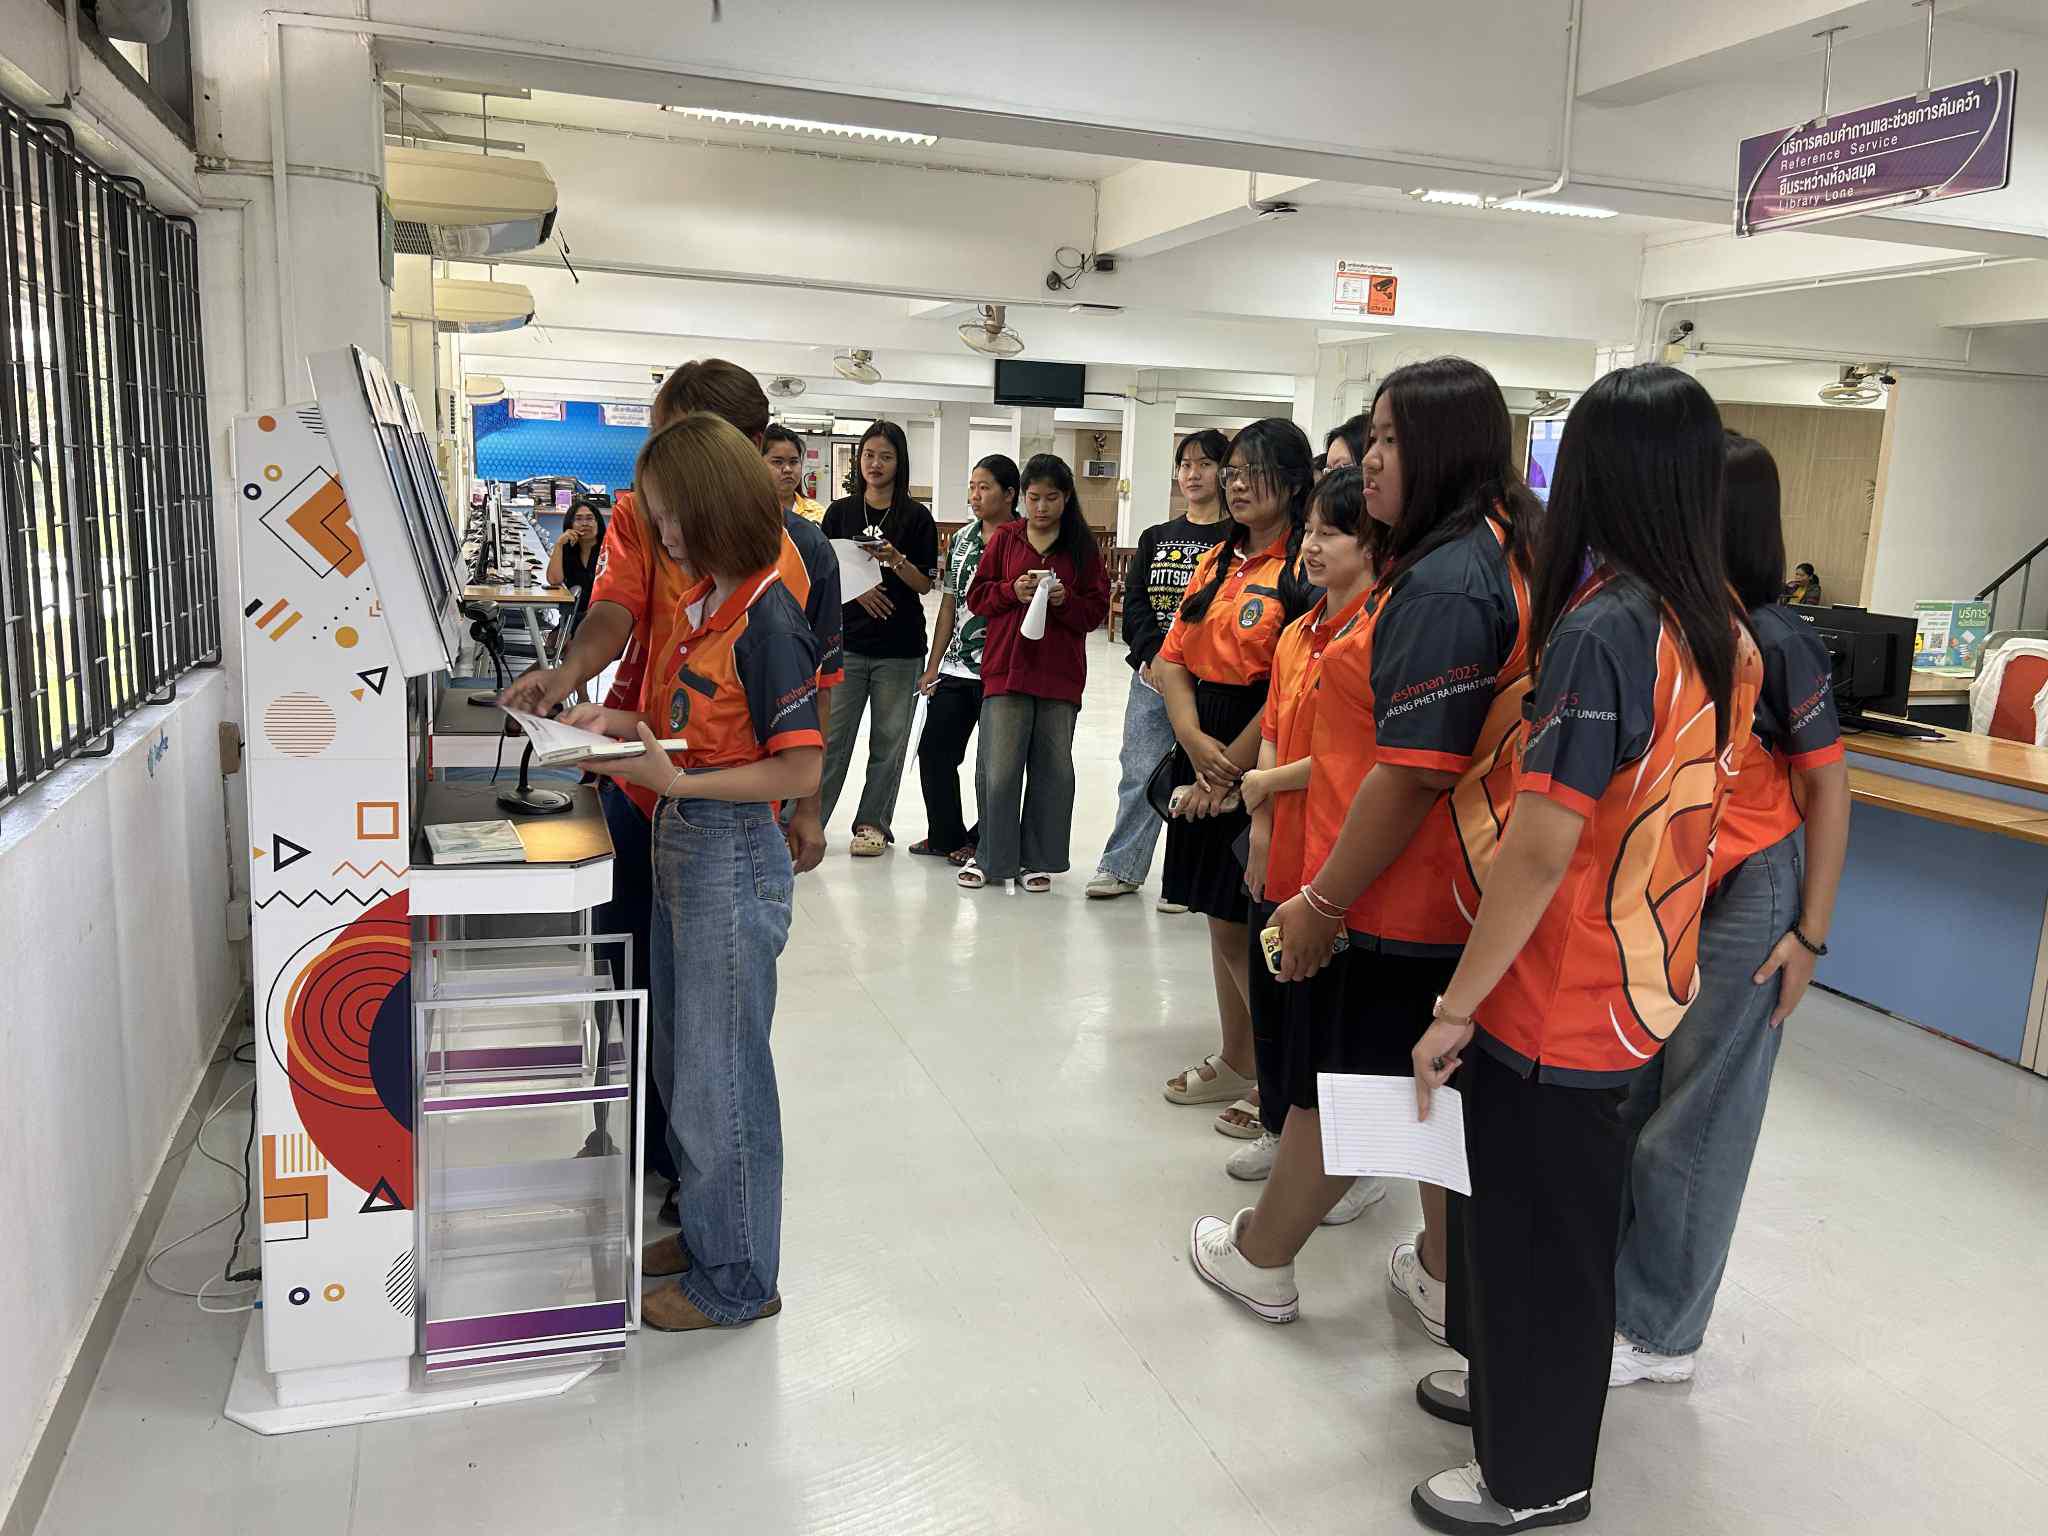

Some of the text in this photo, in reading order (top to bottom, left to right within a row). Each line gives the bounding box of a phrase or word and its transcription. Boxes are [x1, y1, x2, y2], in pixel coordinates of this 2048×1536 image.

[1781, 134, 1899, 171] Reference Service
[1779, 187, 1855, 211] Library Lone
[1447, 663, 1480, 683] 2025
[1414, 692, 1438, 708] PHET
